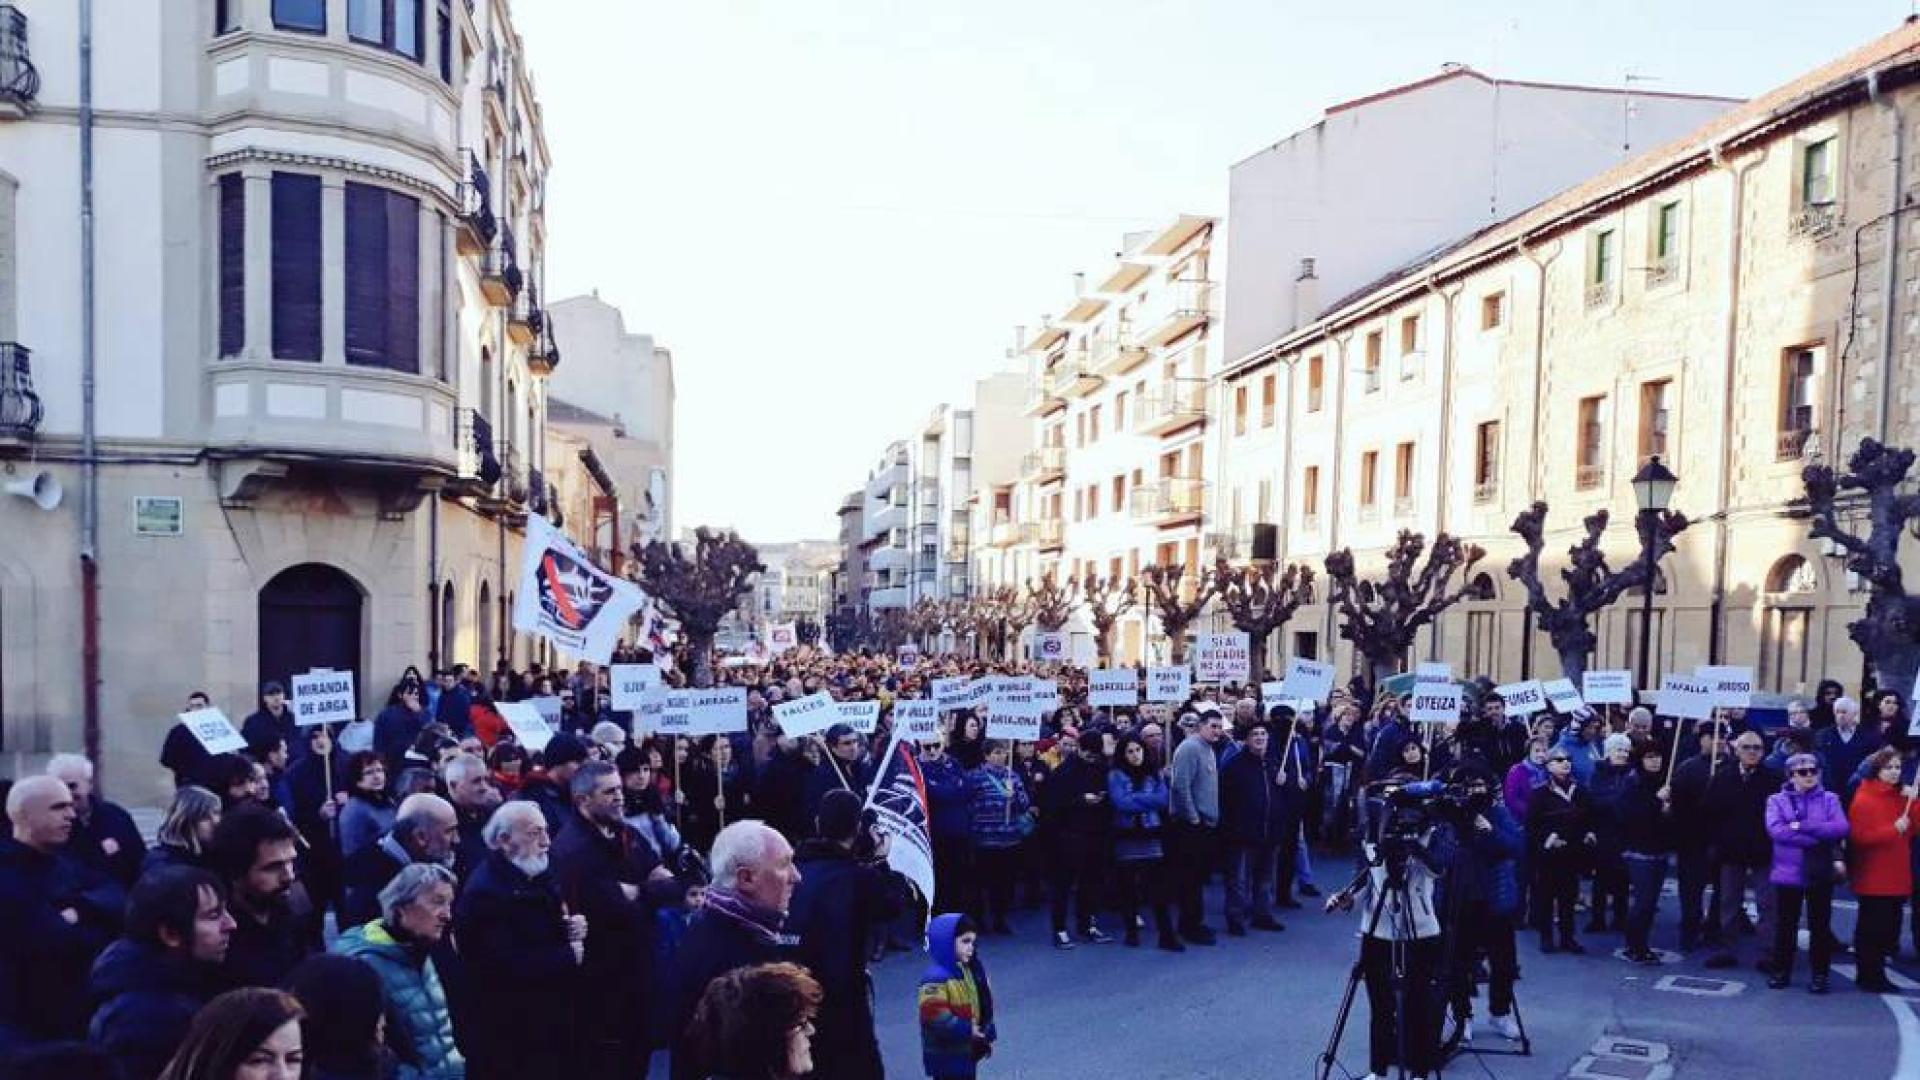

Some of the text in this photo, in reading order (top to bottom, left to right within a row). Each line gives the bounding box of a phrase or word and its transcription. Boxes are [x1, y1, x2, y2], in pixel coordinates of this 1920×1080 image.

[297, 681, 350, 697] MIRANDA
[1665, 681, 1709, 694] TAFALLA
[300, 700, 349, 715] DE ARGA
[692, 695, 741, 706] LARRAGA
[1415, 695, 1456, 711] OTEIZA
